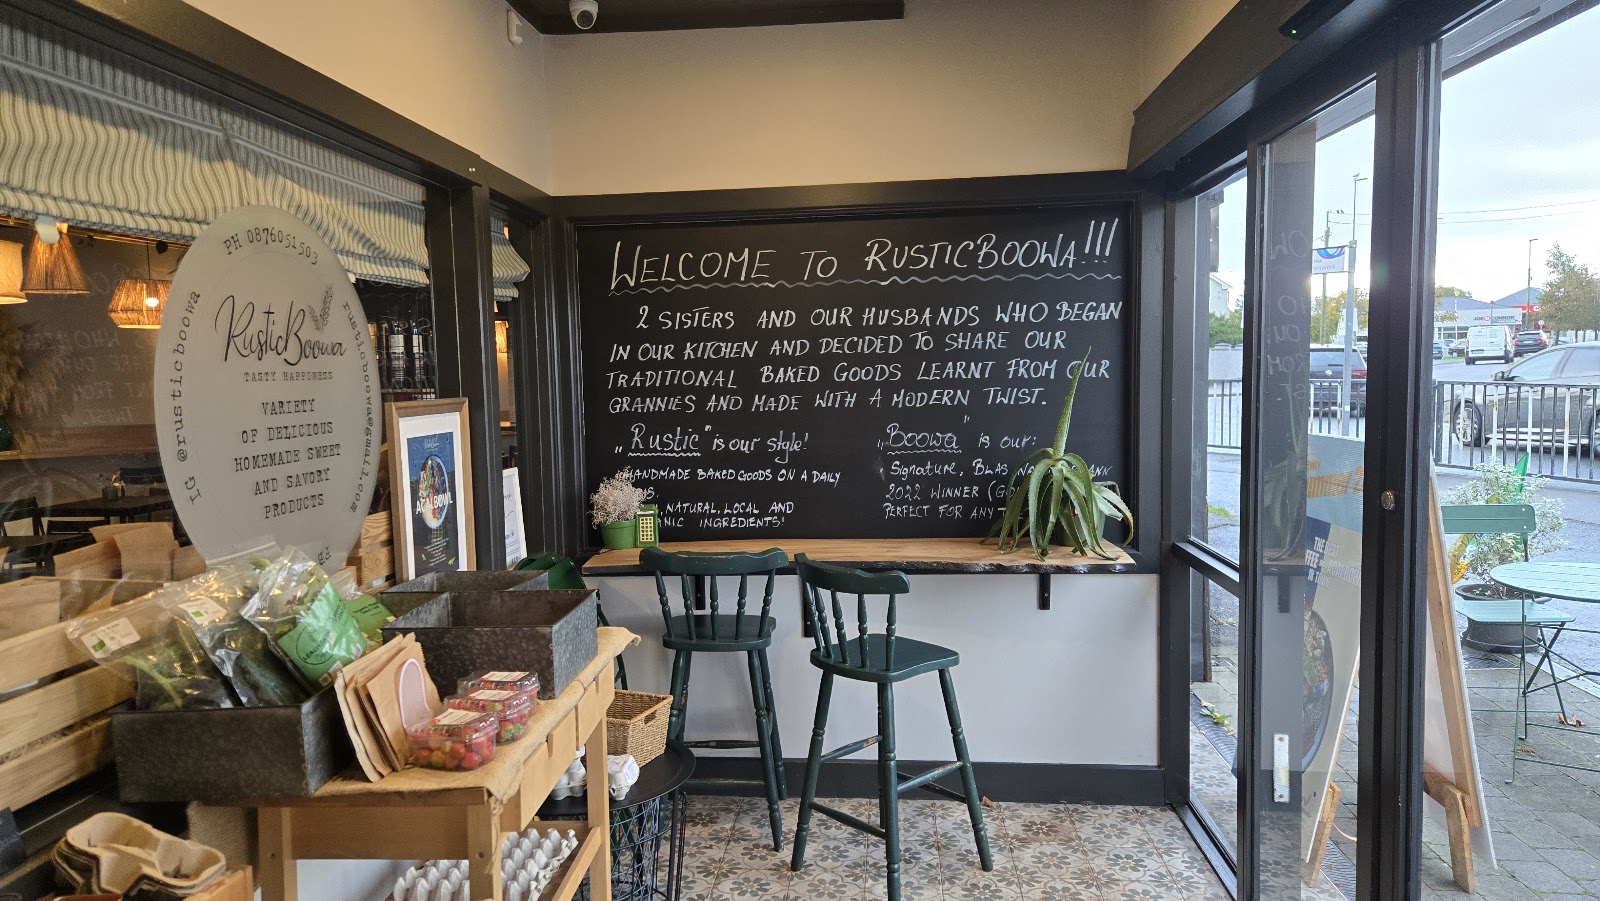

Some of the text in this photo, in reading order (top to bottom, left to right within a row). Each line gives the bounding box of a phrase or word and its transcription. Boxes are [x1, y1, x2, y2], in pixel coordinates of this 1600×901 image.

[223, 227, 319, 266] PH 0876051503
[610, 241, 777, 290] WELCOME
[800, 250, 838, 280] TO
[636, 300, 1123, 330] 2 SISTERS AND OUR HUSBANDS WHO BEGAN
[609, 330, 1067, 363] IN OUR KITCHEN AND DECIDED TO SHARE OUR
[169, 291, 201, 463] @rusticboowa
[243, 371, 334, 383] TASTY HAPPINESS
[606, 358, 1111, 390] TRADITIONAL BAKED GOODS LEARNT FROM OUR
[261, 399, 316, 416] VARIETY
[343, 300, 375, 513] rusticboowa@gmail.com
[608, 386, 1047, 414] GRANNIES AND MADE WITH A MODERN TWIST.
[241, 421, 334, 444] OF DELICIOUS
[977, 432, 991, 449] is
[234, 443, 342, 472] HOMEMADE SWEET
[712, 433, 726, 451] is
[729, 436, 761, 454] our
[767, 430, 809, 464] style!
[697, 468, 736, 481] BAKED
[737, 468, 773, 481] GOODS
[777, 468, 797, 482] ON
[800, 471, 809, 482] A
[811, 470, 841, 488] DAILY
[972, 457, 1009, 476] BLAS
[184, 476, 202, 505] IG
[254, 467, 331, 496] AND SAVORY
[885, 483, 921, 501] 2022
[930, 483, 980, 500] WINNER
[263, 493, 325, 519] PRODUCTS
[434, 492, 454, 509] BOWL
[724, 502, 760, 514] LOCAL
[768, 501, 794, 514] AND
[883, 503, 931, 519] PERFECT
[938, 504, 963, 519] FOR
[970, 505, 995, 519] ANY
[699, 516, 785, 529] INGREDIENTS!
